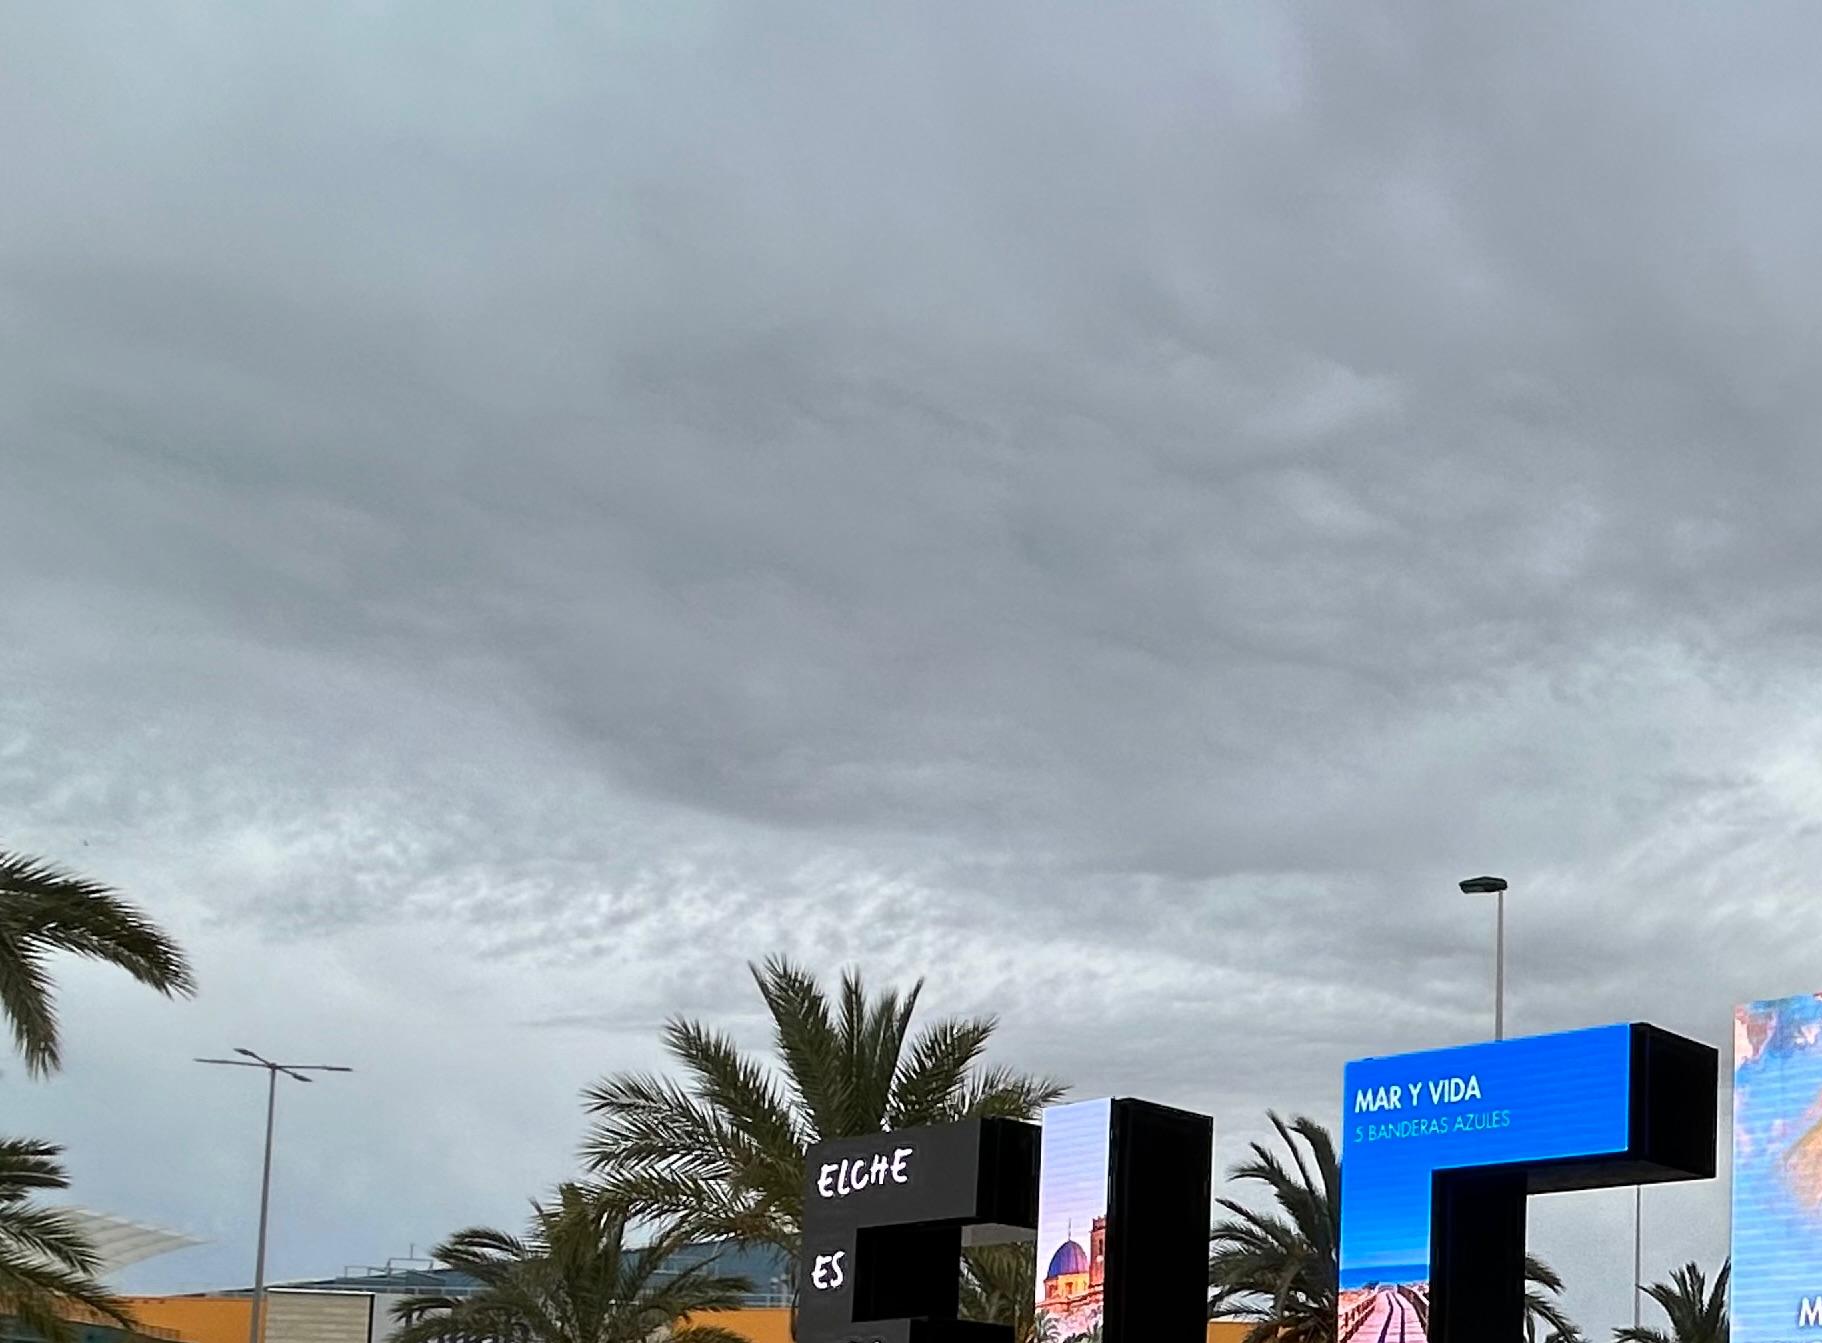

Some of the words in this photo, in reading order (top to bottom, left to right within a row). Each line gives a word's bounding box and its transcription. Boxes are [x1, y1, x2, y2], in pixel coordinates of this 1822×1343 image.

[1354, 1085, 1402, 1113] MAR
[1408, 1081, 1422, 1106] Y
[1428, 1074, 1481, 1105] VIDA
[1353, 1126, 1364, 1143] 5
[1368, 1117, 1448, 1141] BANDERAS
[1453, 1110, 1511, 1132] AZULES
[817, 1148, 913, 1197] ELCHE
[811, 1251, 845, 1289] ES
